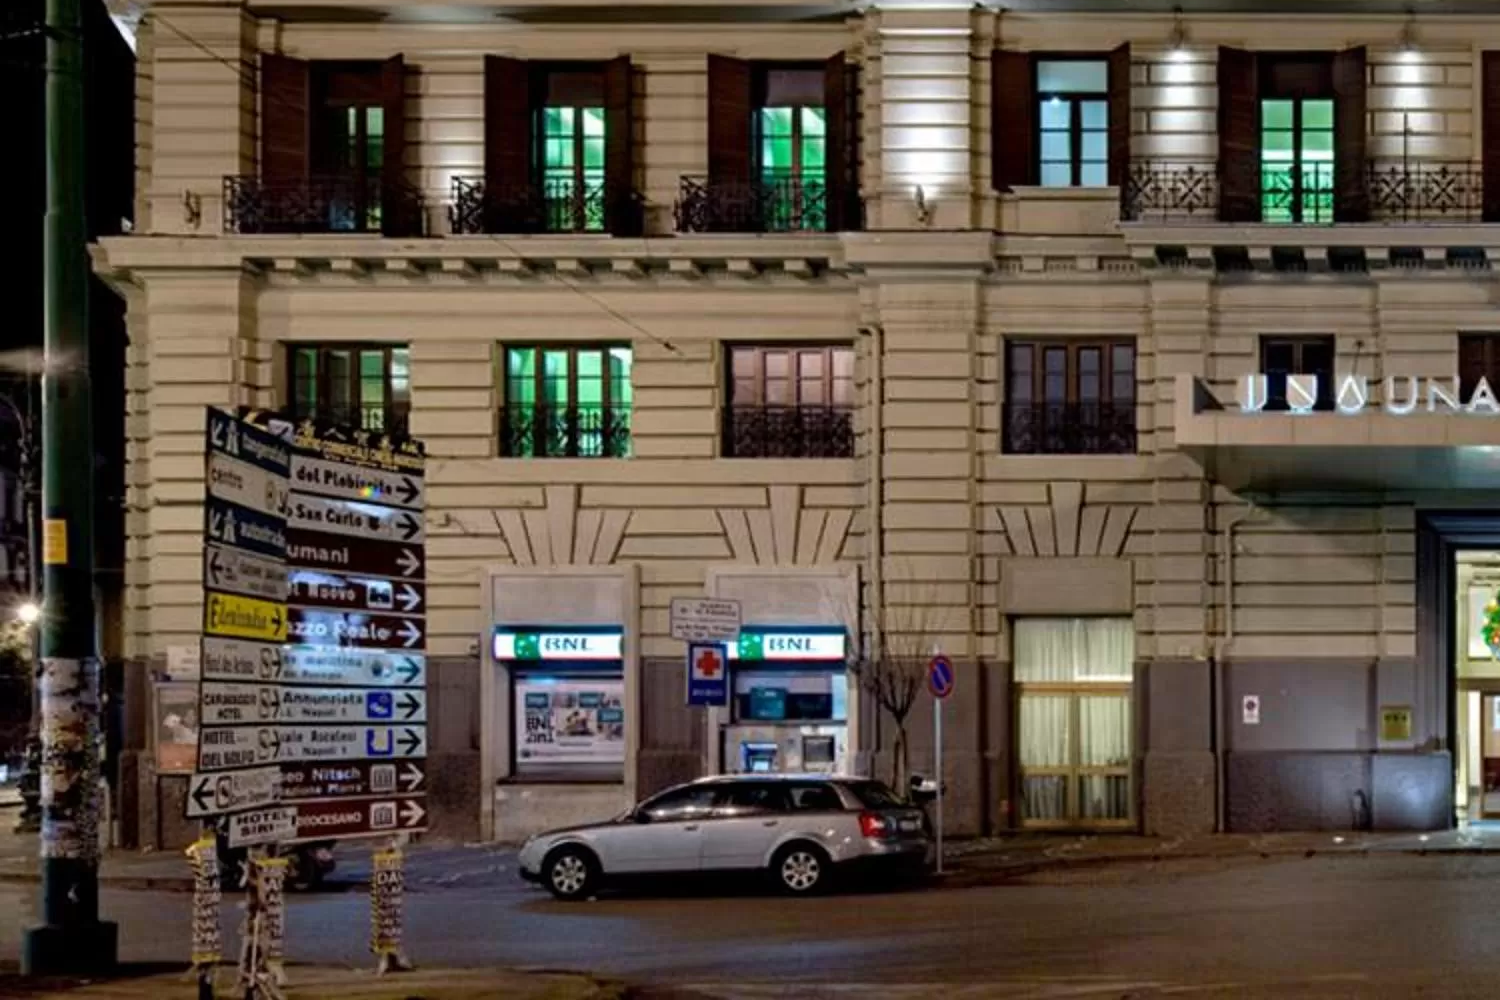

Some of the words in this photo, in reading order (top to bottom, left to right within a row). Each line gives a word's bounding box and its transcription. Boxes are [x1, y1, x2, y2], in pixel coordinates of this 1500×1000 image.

[1386, 375, 1500, 414] UNA
[295, 503, 322, 520] San
[544, 636, 591, 651] BNL
[768, 637, 816, 651] BNL
